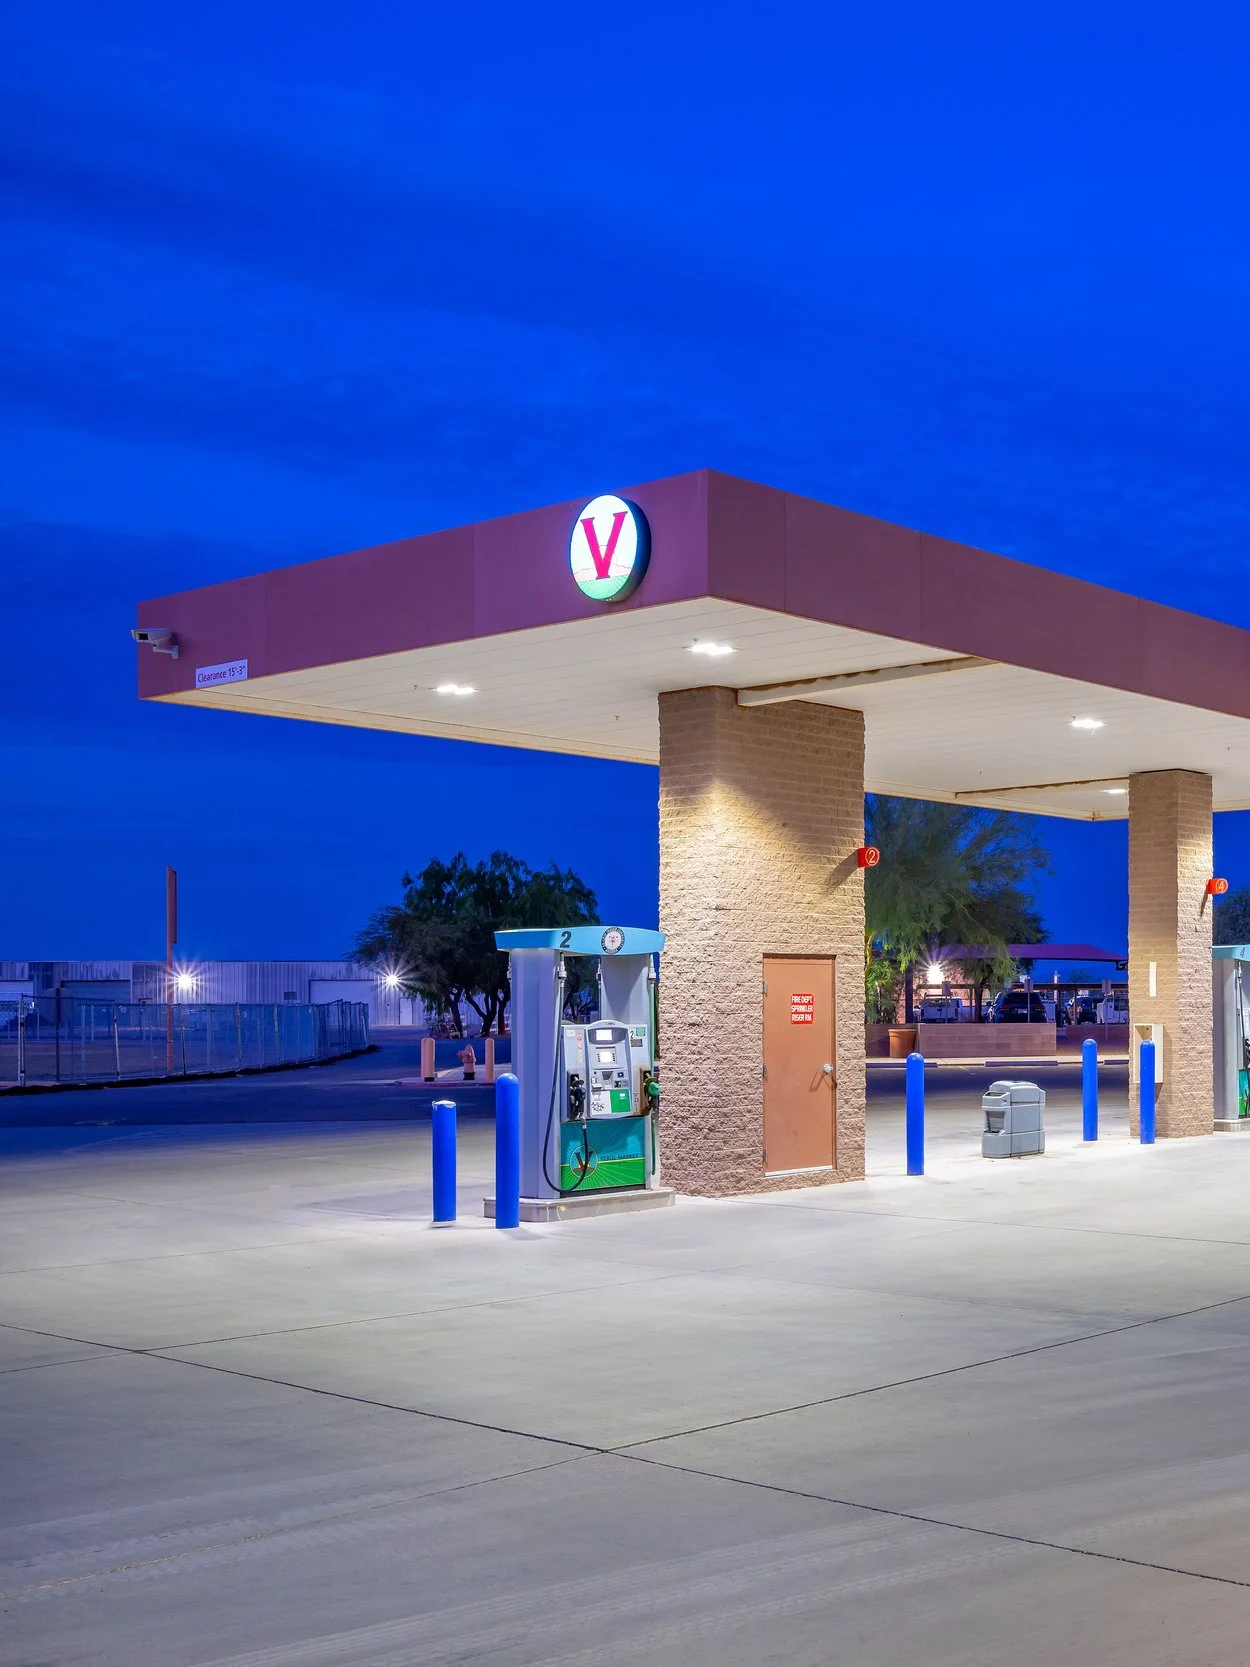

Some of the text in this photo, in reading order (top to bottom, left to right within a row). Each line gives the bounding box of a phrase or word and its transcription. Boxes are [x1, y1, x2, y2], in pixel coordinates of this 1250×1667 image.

[580, 511, 628, 580] V
[197, 671, 226, 683] Clearance
[869, 850, 876, 863] 2
[1218, 881, 1224, 892] 4
[560, 931, 572, 948] 2
[1240, 947, 1245, 958] 4
[630, 1030, 634, 1040] 2
